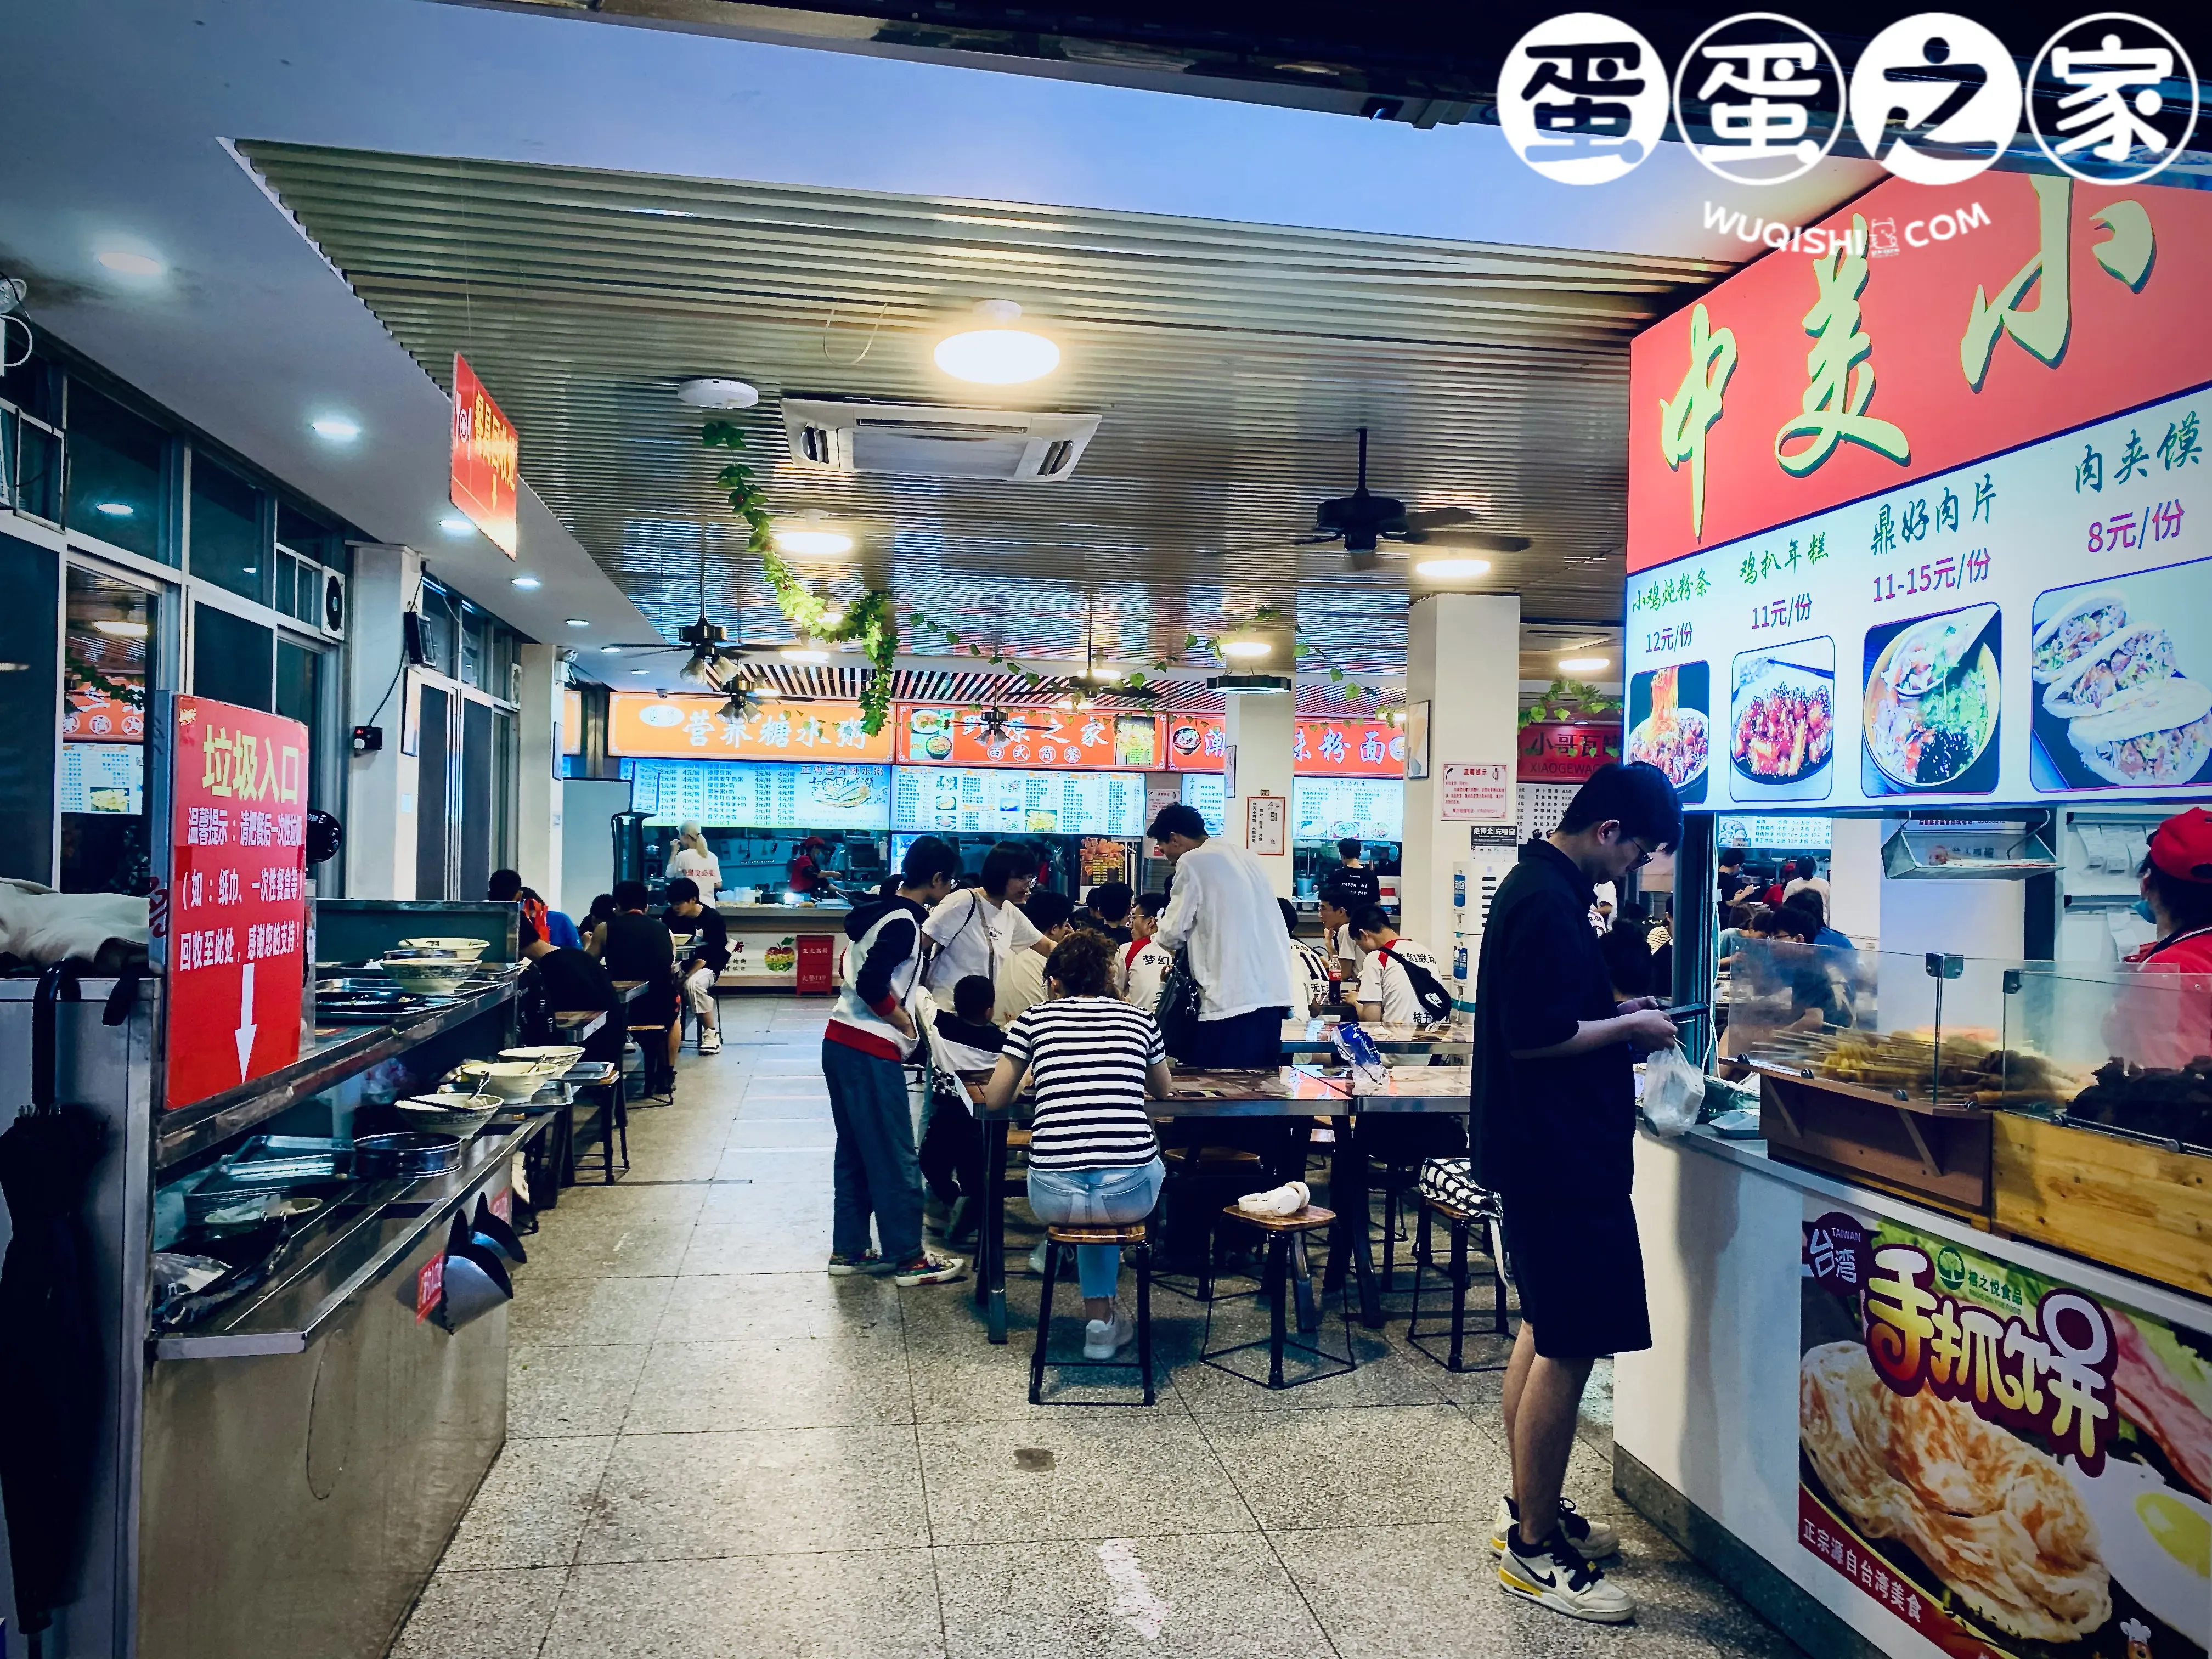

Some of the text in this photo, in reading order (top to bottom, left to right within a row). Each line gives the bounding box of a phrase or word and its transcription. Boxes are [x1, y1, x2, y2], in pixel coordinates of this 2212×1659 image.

[2075, 410, 2202, 495] 肉夹馍
[1870, 474, 1997, 558] 鼎好肉片
[2087, 499, 2185, 555] 8元/份
[1739, 532, 1830, 586] 鸡扒年糕
[1873, 546, 1992, 603] 11-15元/份
[1632, 567, 1711, 614] 小鸡炖粉条
[1751, 592, 1813, 630] 11元/份
[1645, 622, 1694, 653] 12元/份
[682, 708, 867, 751] 营养糖水粥
[202, 724, 300, 805] 垃圾入口
[1809, 1229, 1857, 1284] 台湾
[1831, 1227, 1861, 1242] TAIWAN
[1867, 1248, 2109, 1458] 手抓饼
[1804, 1518, 1923, 1623] 正宗源自台湾美食
